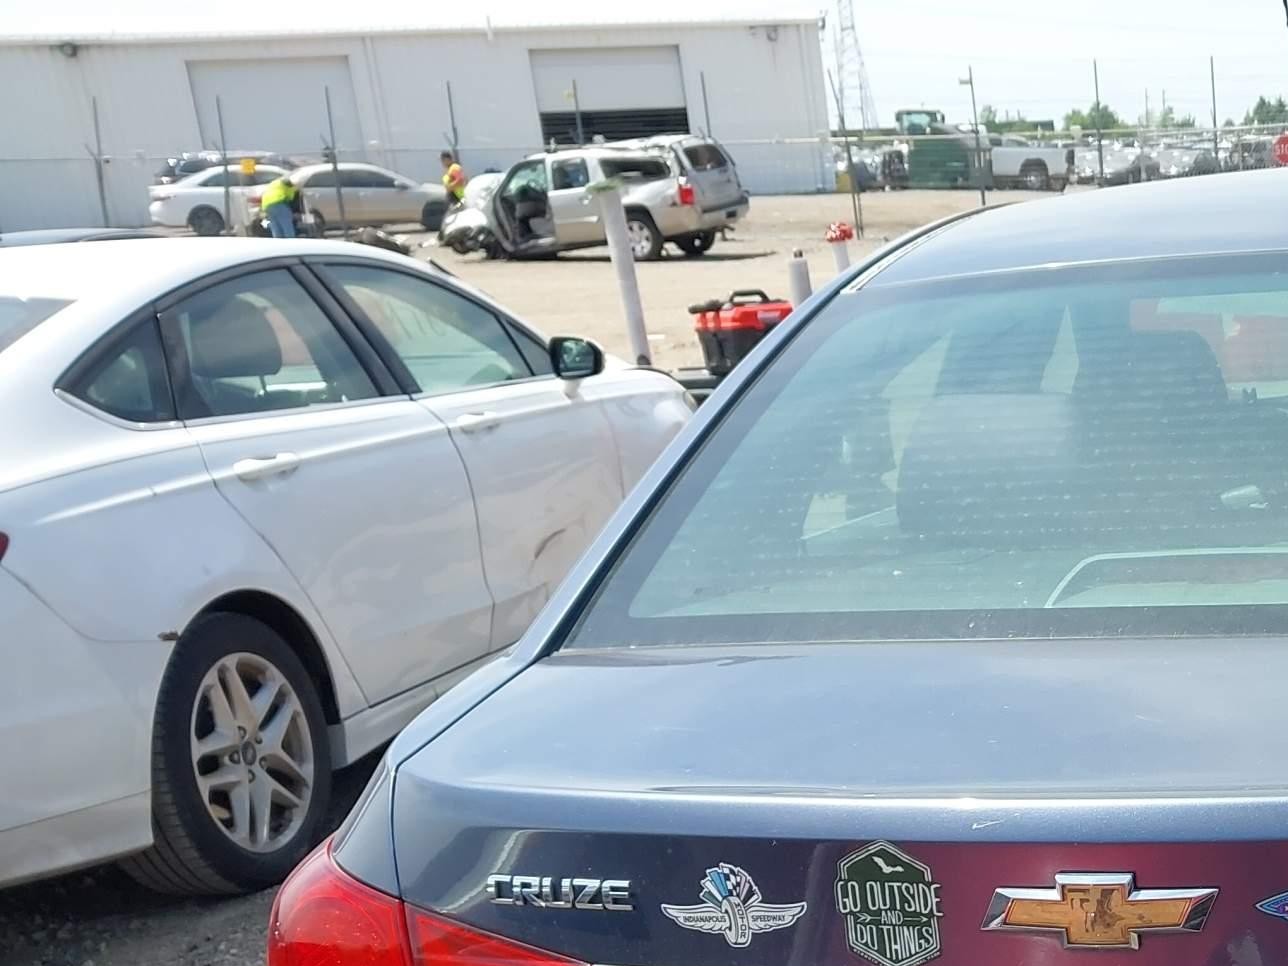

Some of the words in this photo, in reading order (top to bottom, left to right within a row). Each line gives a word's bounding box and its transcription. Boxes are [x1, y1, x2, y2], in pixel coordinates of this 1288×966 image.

[486, 874, 633, 911] CRUZE
[838, 881, 860, 913] GO
[866, 881, 943, 916] OUTSIDE
[682, 915, 727, 923] INDIANAPOLIS
[733, 902, 747, 939] MOTOR
[751, 914, 785, 922] SPEEDWAY
[881, 910, 904, 925] AND
[856, 923, 878, 950] DO
[879, 925, 933, 960] THINGS
